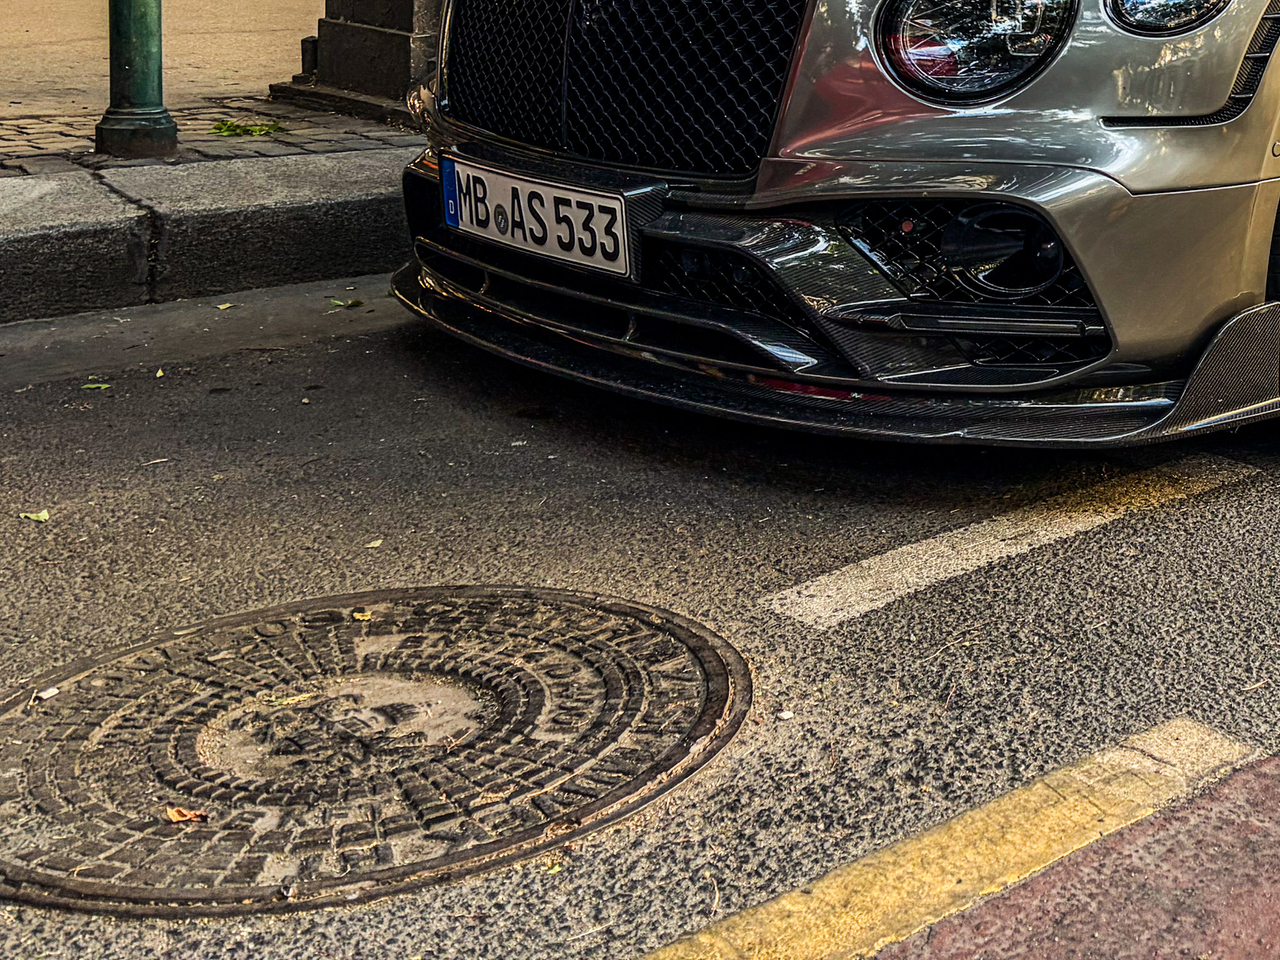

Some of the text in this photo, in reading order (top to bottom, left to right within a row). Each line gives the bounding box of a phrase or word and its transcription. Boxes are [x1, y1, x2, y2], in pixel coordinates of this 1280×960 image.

[456, 169, 620, 262] MB AS 533
